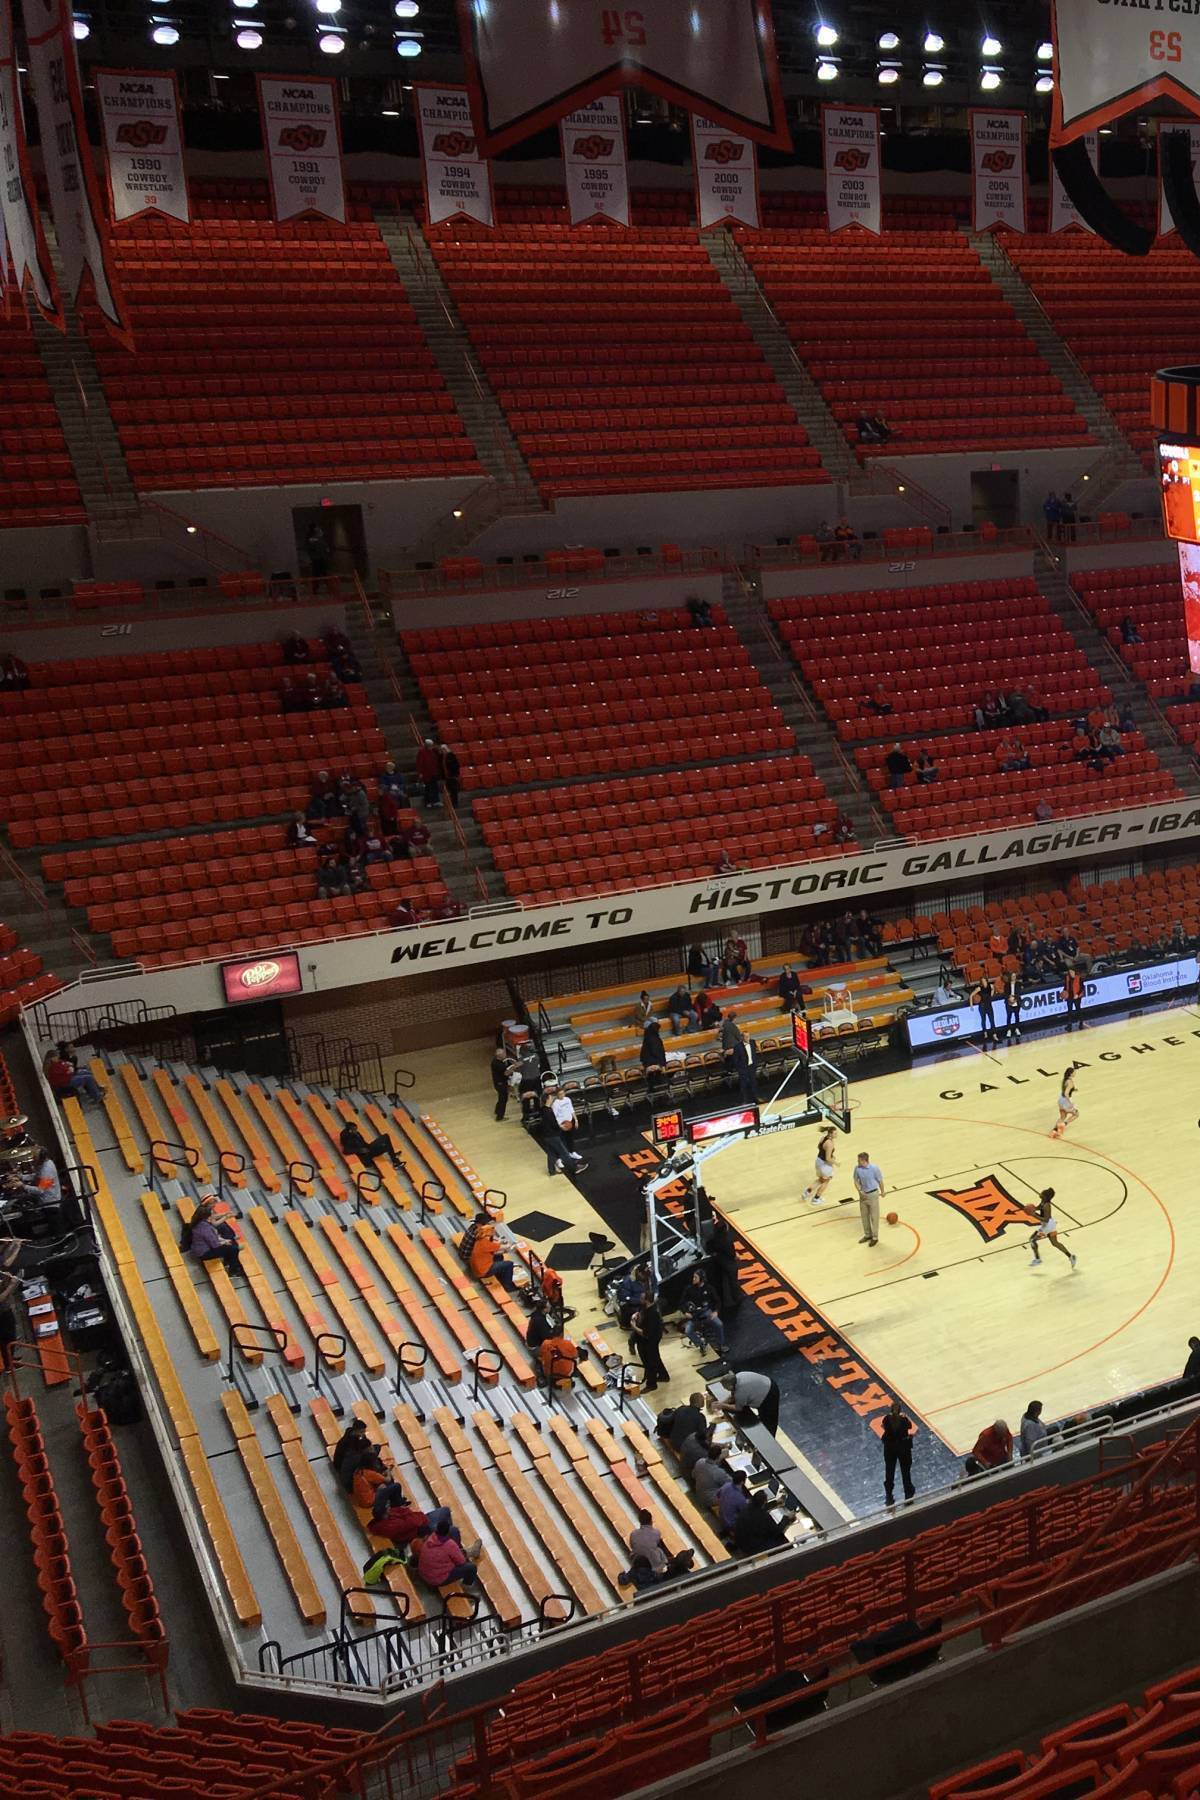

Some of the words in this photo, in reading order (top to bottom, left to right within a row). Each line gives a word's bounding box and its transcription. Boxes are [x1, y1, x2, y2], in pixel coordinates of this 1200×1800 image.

[119, 83, 154, 94] NCAA
[282, 89, 315, 99] NCAA
[104, 96, 173, 109] CHAMPIONS
[437, 96, 467, 107] NCAA
[268, 102, 331, 115] CHAMPIONS
[423, 108, 472, 121] CHAMPIO
[563, 114, 619, 125] CHAMPIONS
[839, 117, 863, 127] NCAA
[987, 120, 1009, 129] NCAA
[115, 121, 168, 147] OSU
[278, 125, 327, 151] OSU
[828, 128, 875, 139] CHAMPIONS
[976, 130, 1019, 141] CHAMPIONS
[572, 135, 615, 159] OSU
[704, 140, 744, 164] OSU
[131, 159, 161, 170] 1990
[834, 149, 871, 171] OSU
[981, 150, 1016, 172] OSU
[292, 161, 320, 172] 1991
[127, 173, 168, 183] COWBOY
[444, 167, 470, 178] 1994
[714, 173, 739, 183] 2000
[289, 176, 325, 185] COWBOY
[441, 180, 475, 190] COWBOY
[842, 181, 864, 190] 2003
[988, 181, 1009, 191] 2004
[125, 183, 174, 192] WRESTLING
[712, 186, 742, 194] COWBOY
[439, 189, 479, 198] WRESTLING
[889, 561, 915, 573] 213
[546, 588, 580, 600] 212
[101, 623, 132, 637] 211
[390, 917, 574, 963] WELCOME
[586, 908, 632, 928] TO
[689, 862, 887, 913] HISTORIC
